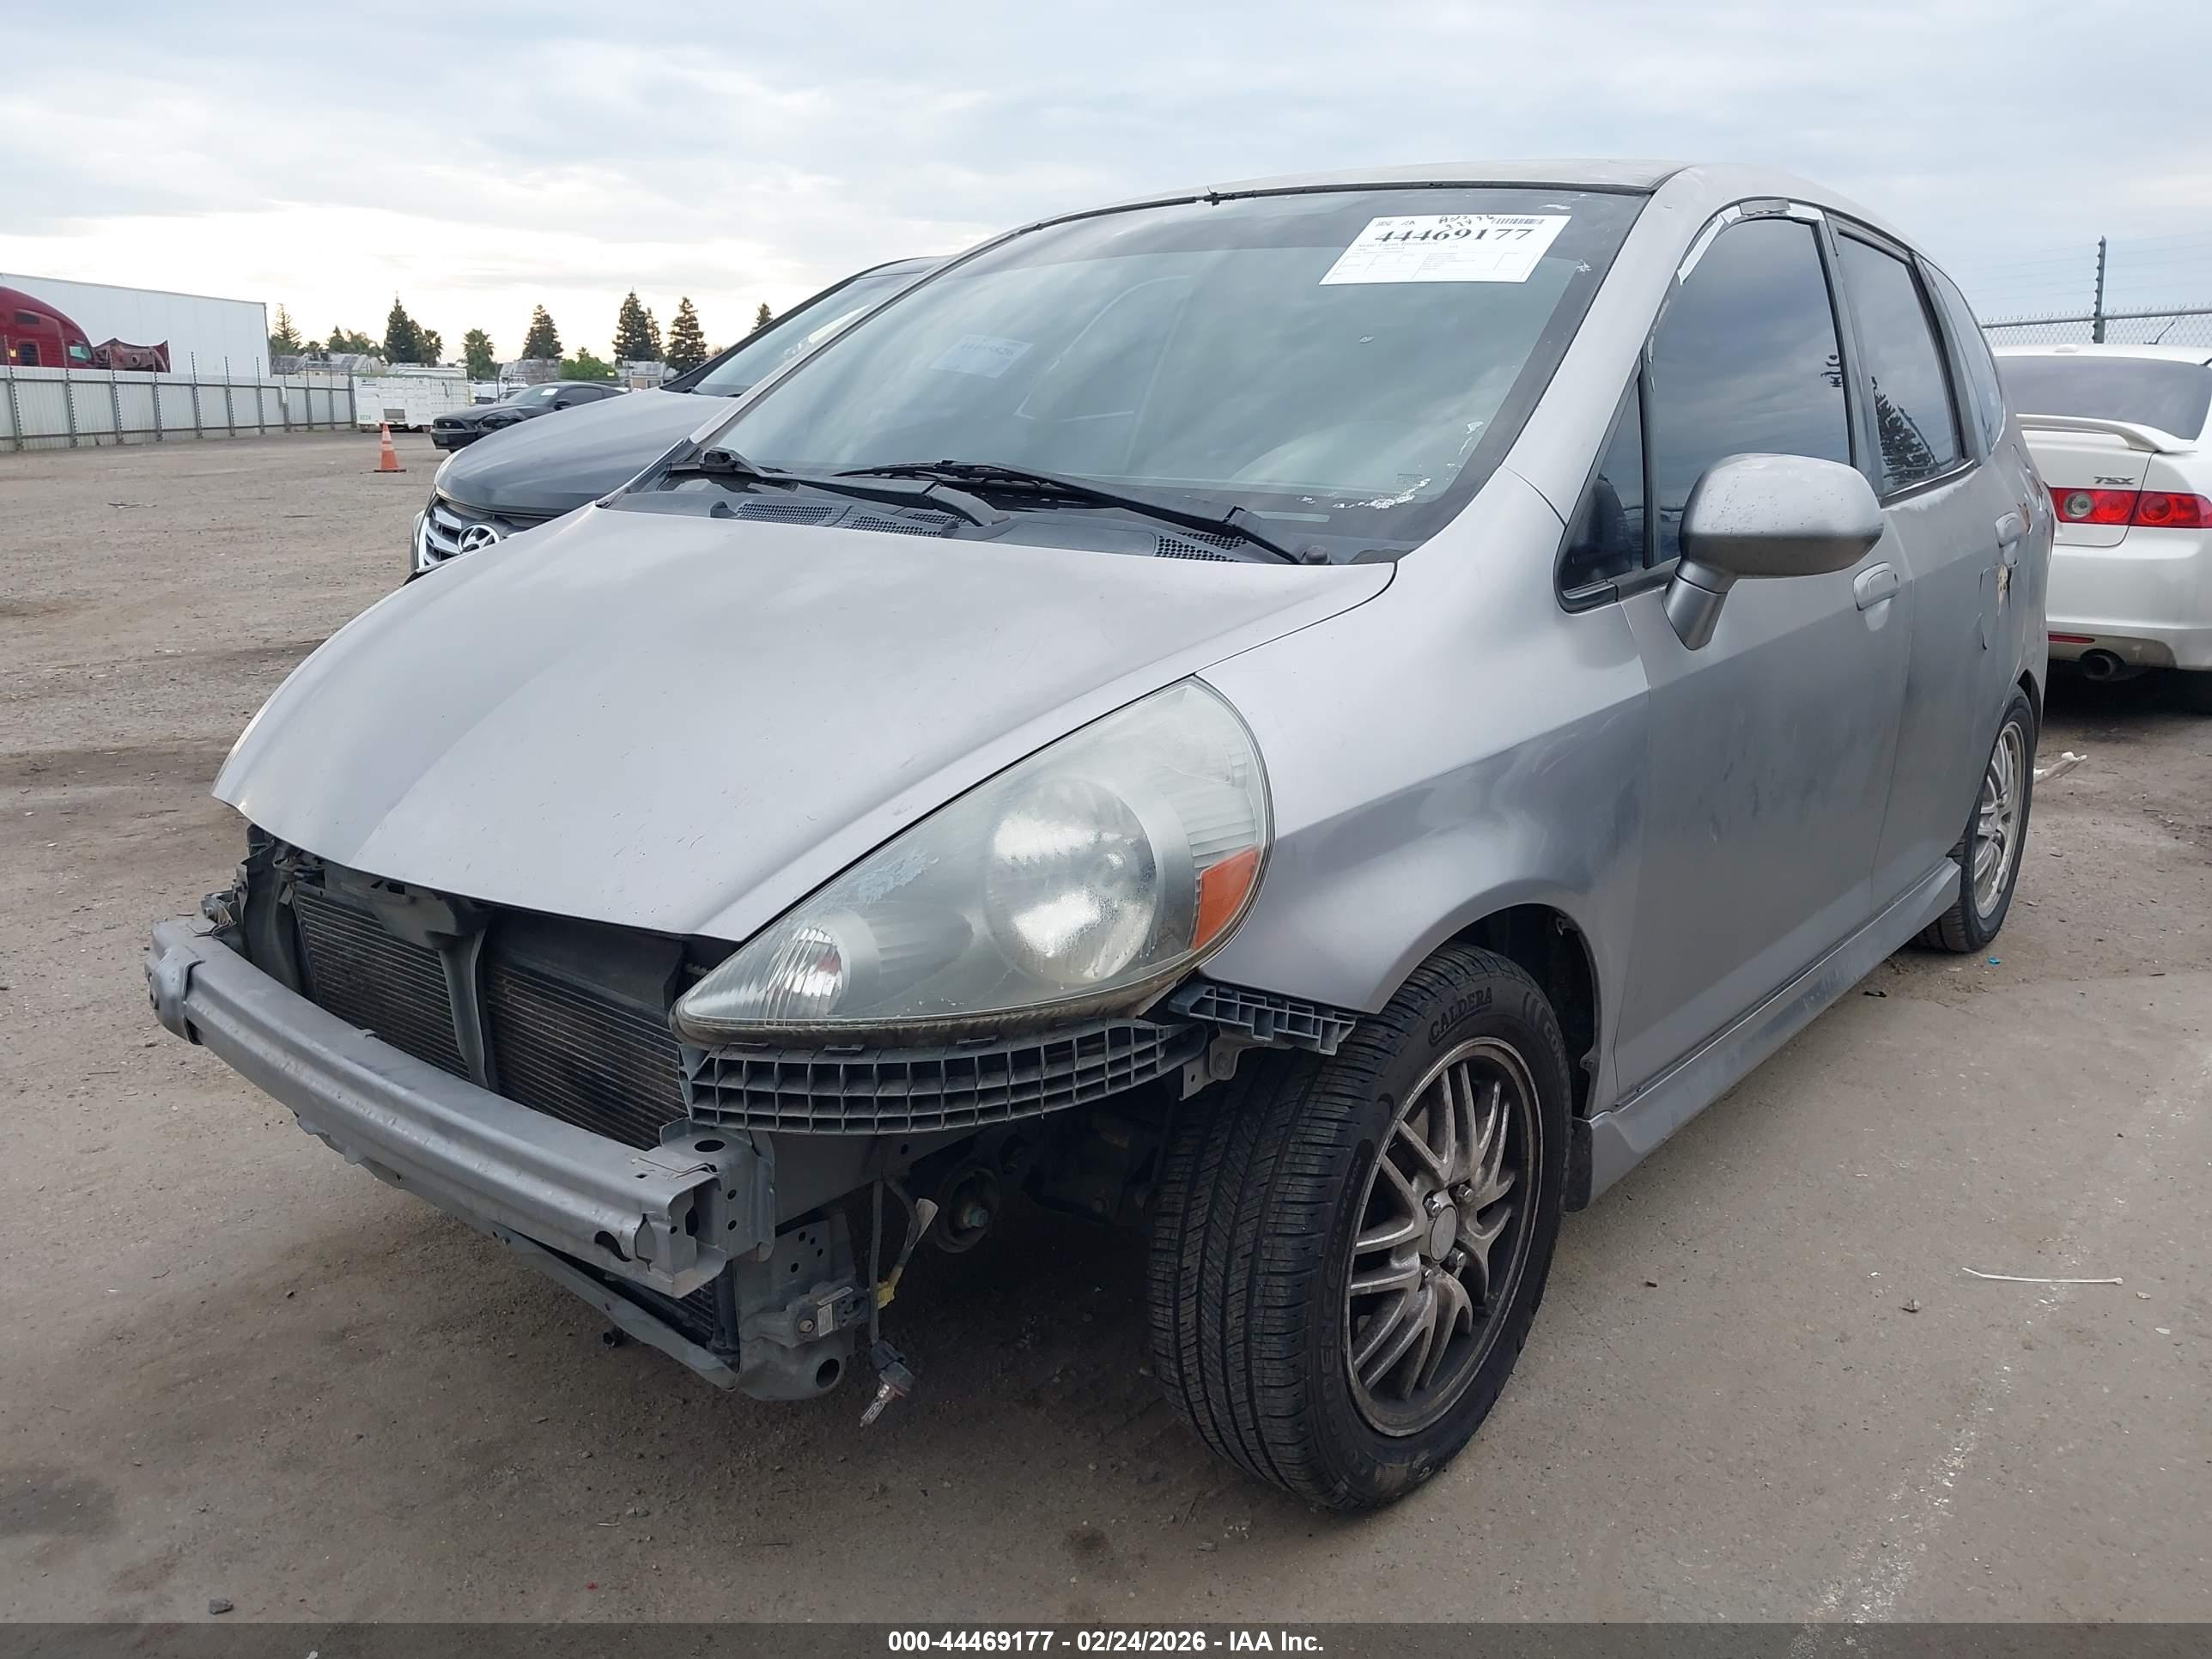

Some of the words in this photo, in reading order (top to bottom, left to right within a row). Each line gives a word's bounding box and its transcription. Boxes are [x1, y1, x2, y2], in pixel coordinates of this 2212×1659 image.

[1374, 228, 1536, 242] 44469177
[2094, 475, 2136, 485] TSX
[1427, 987, 1492, 1046] CALDERA
